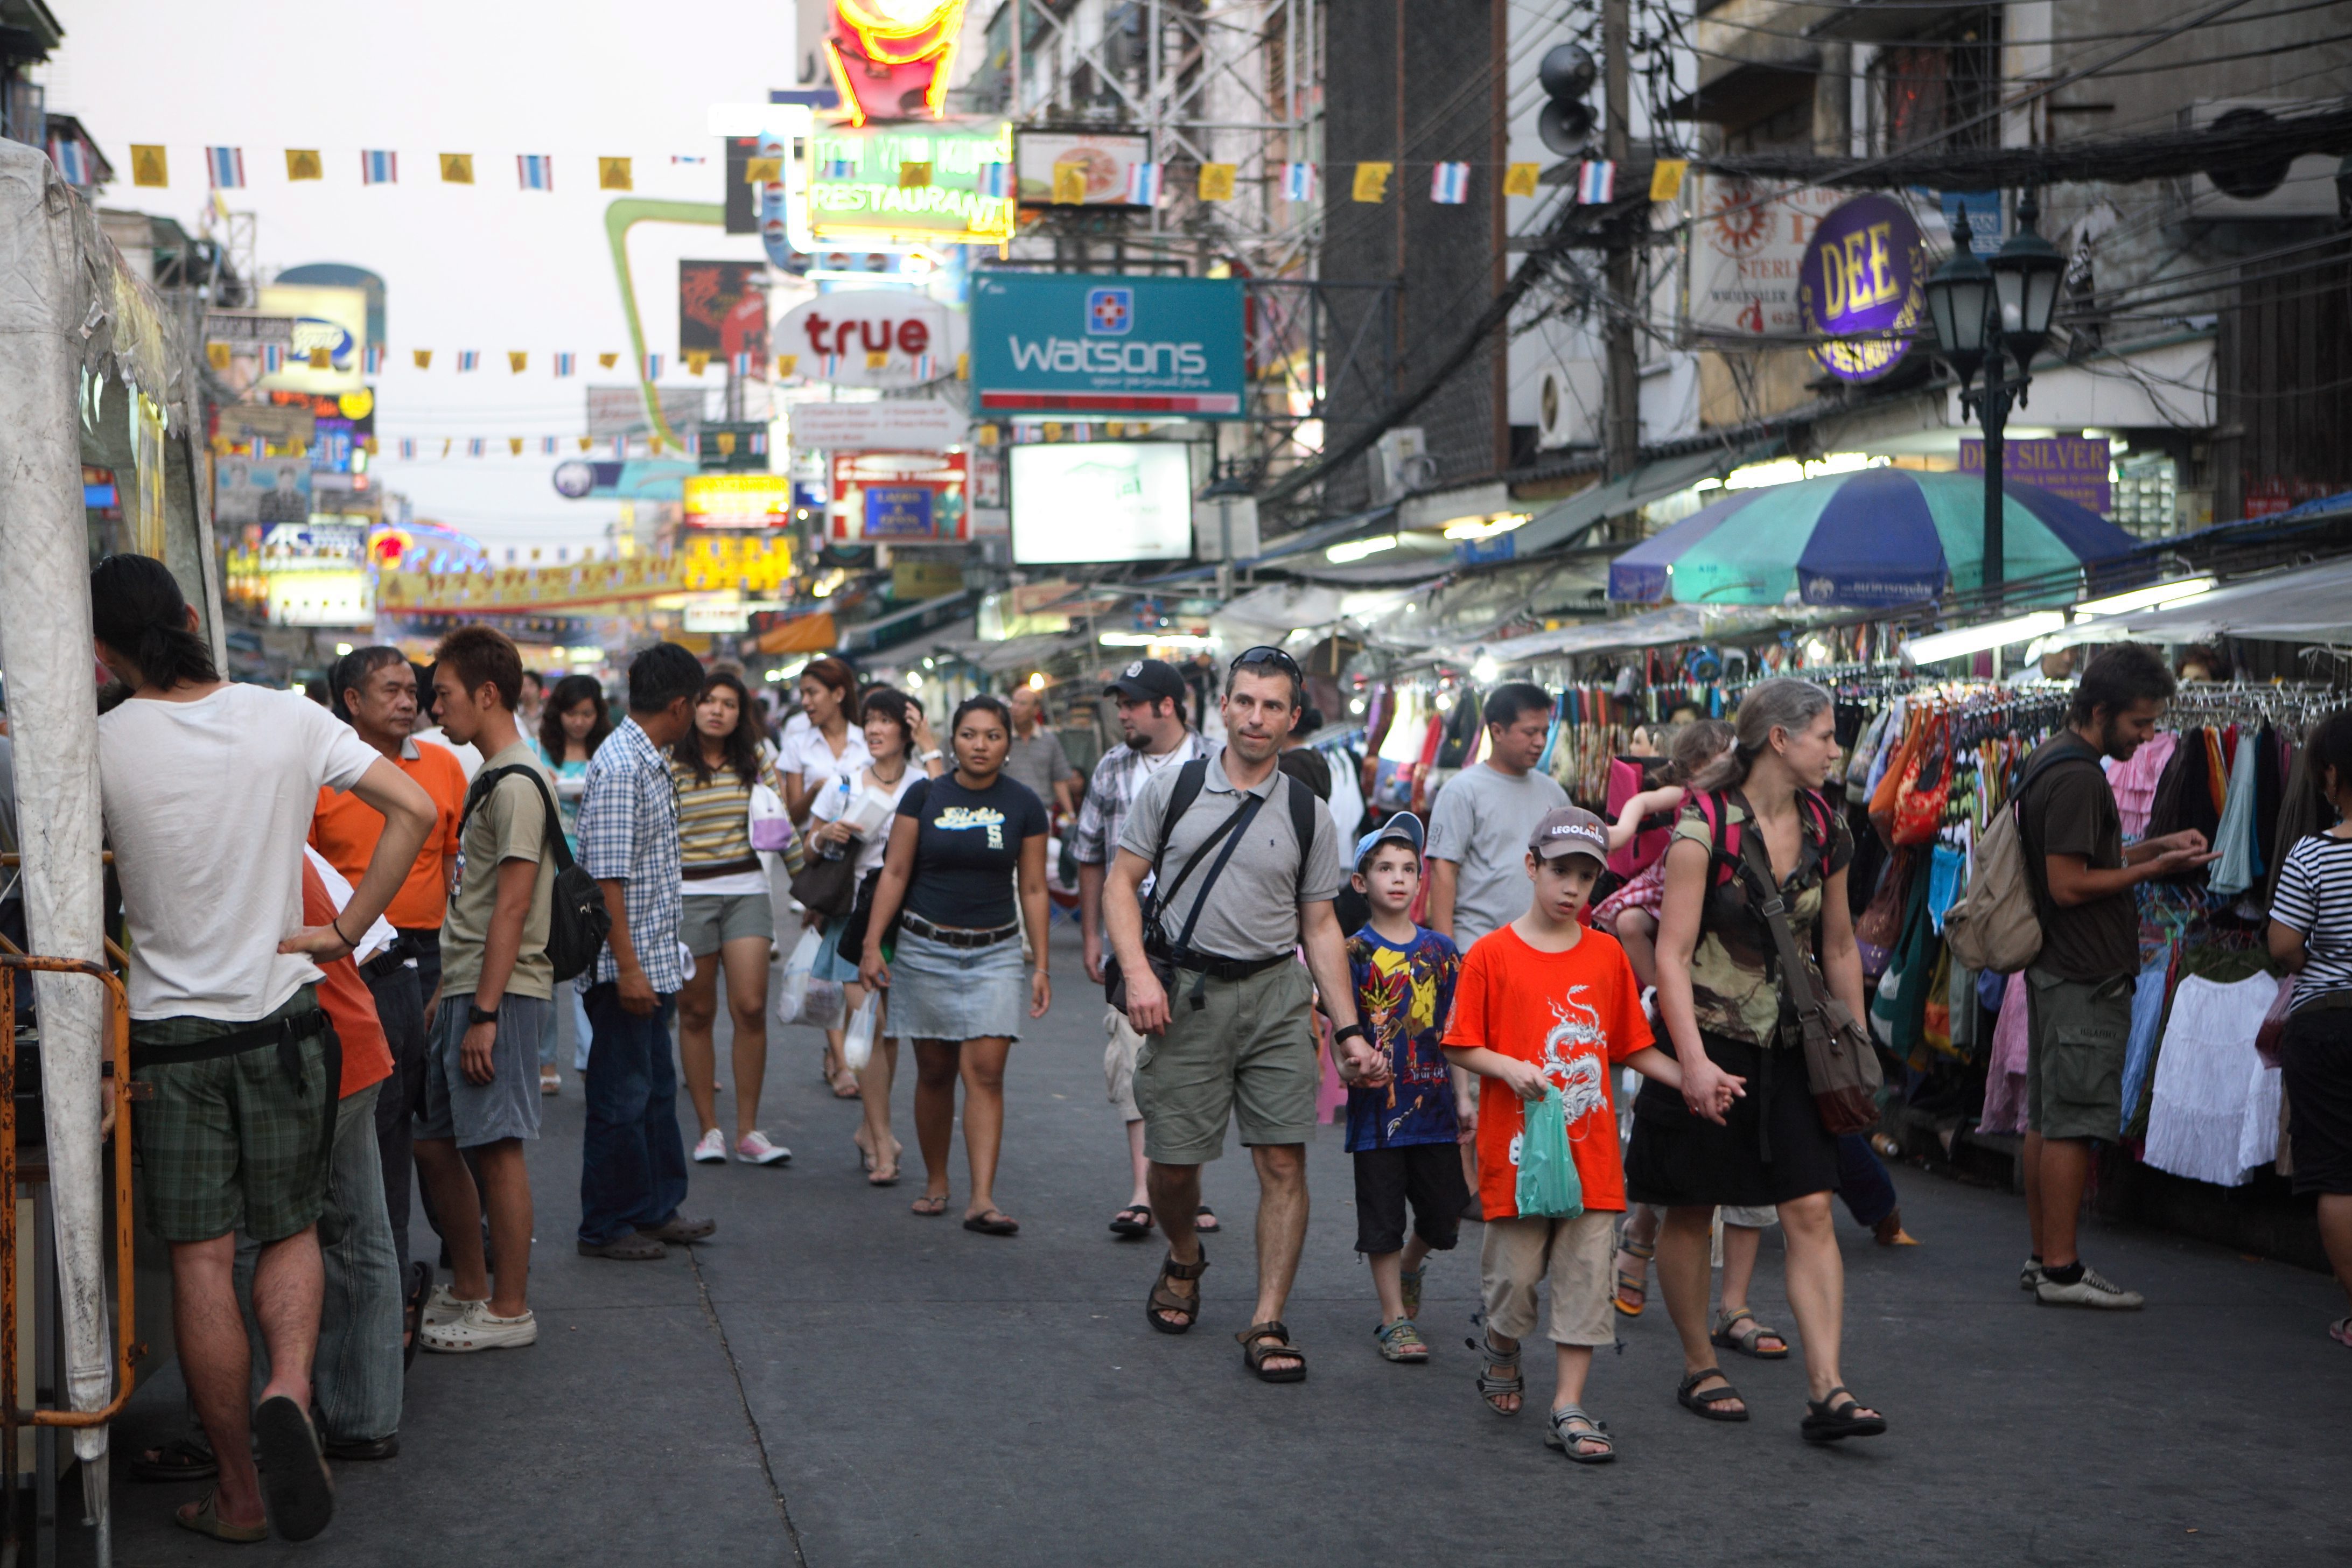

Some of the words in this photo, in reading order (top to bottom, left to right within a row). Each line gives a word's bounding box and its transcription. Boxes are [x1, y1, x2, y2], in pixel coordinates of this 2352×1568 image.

[810, 183, 1004, 226] RESTAURANT
[1821, 221, 1901, 320] DEE
[804, 312, 929, 358] true
[1963, 443, 2012, 471] DE
[2019, 439, 2106, 471] SILVER
[1551, 824, 1605, 845] LEGOLAND
